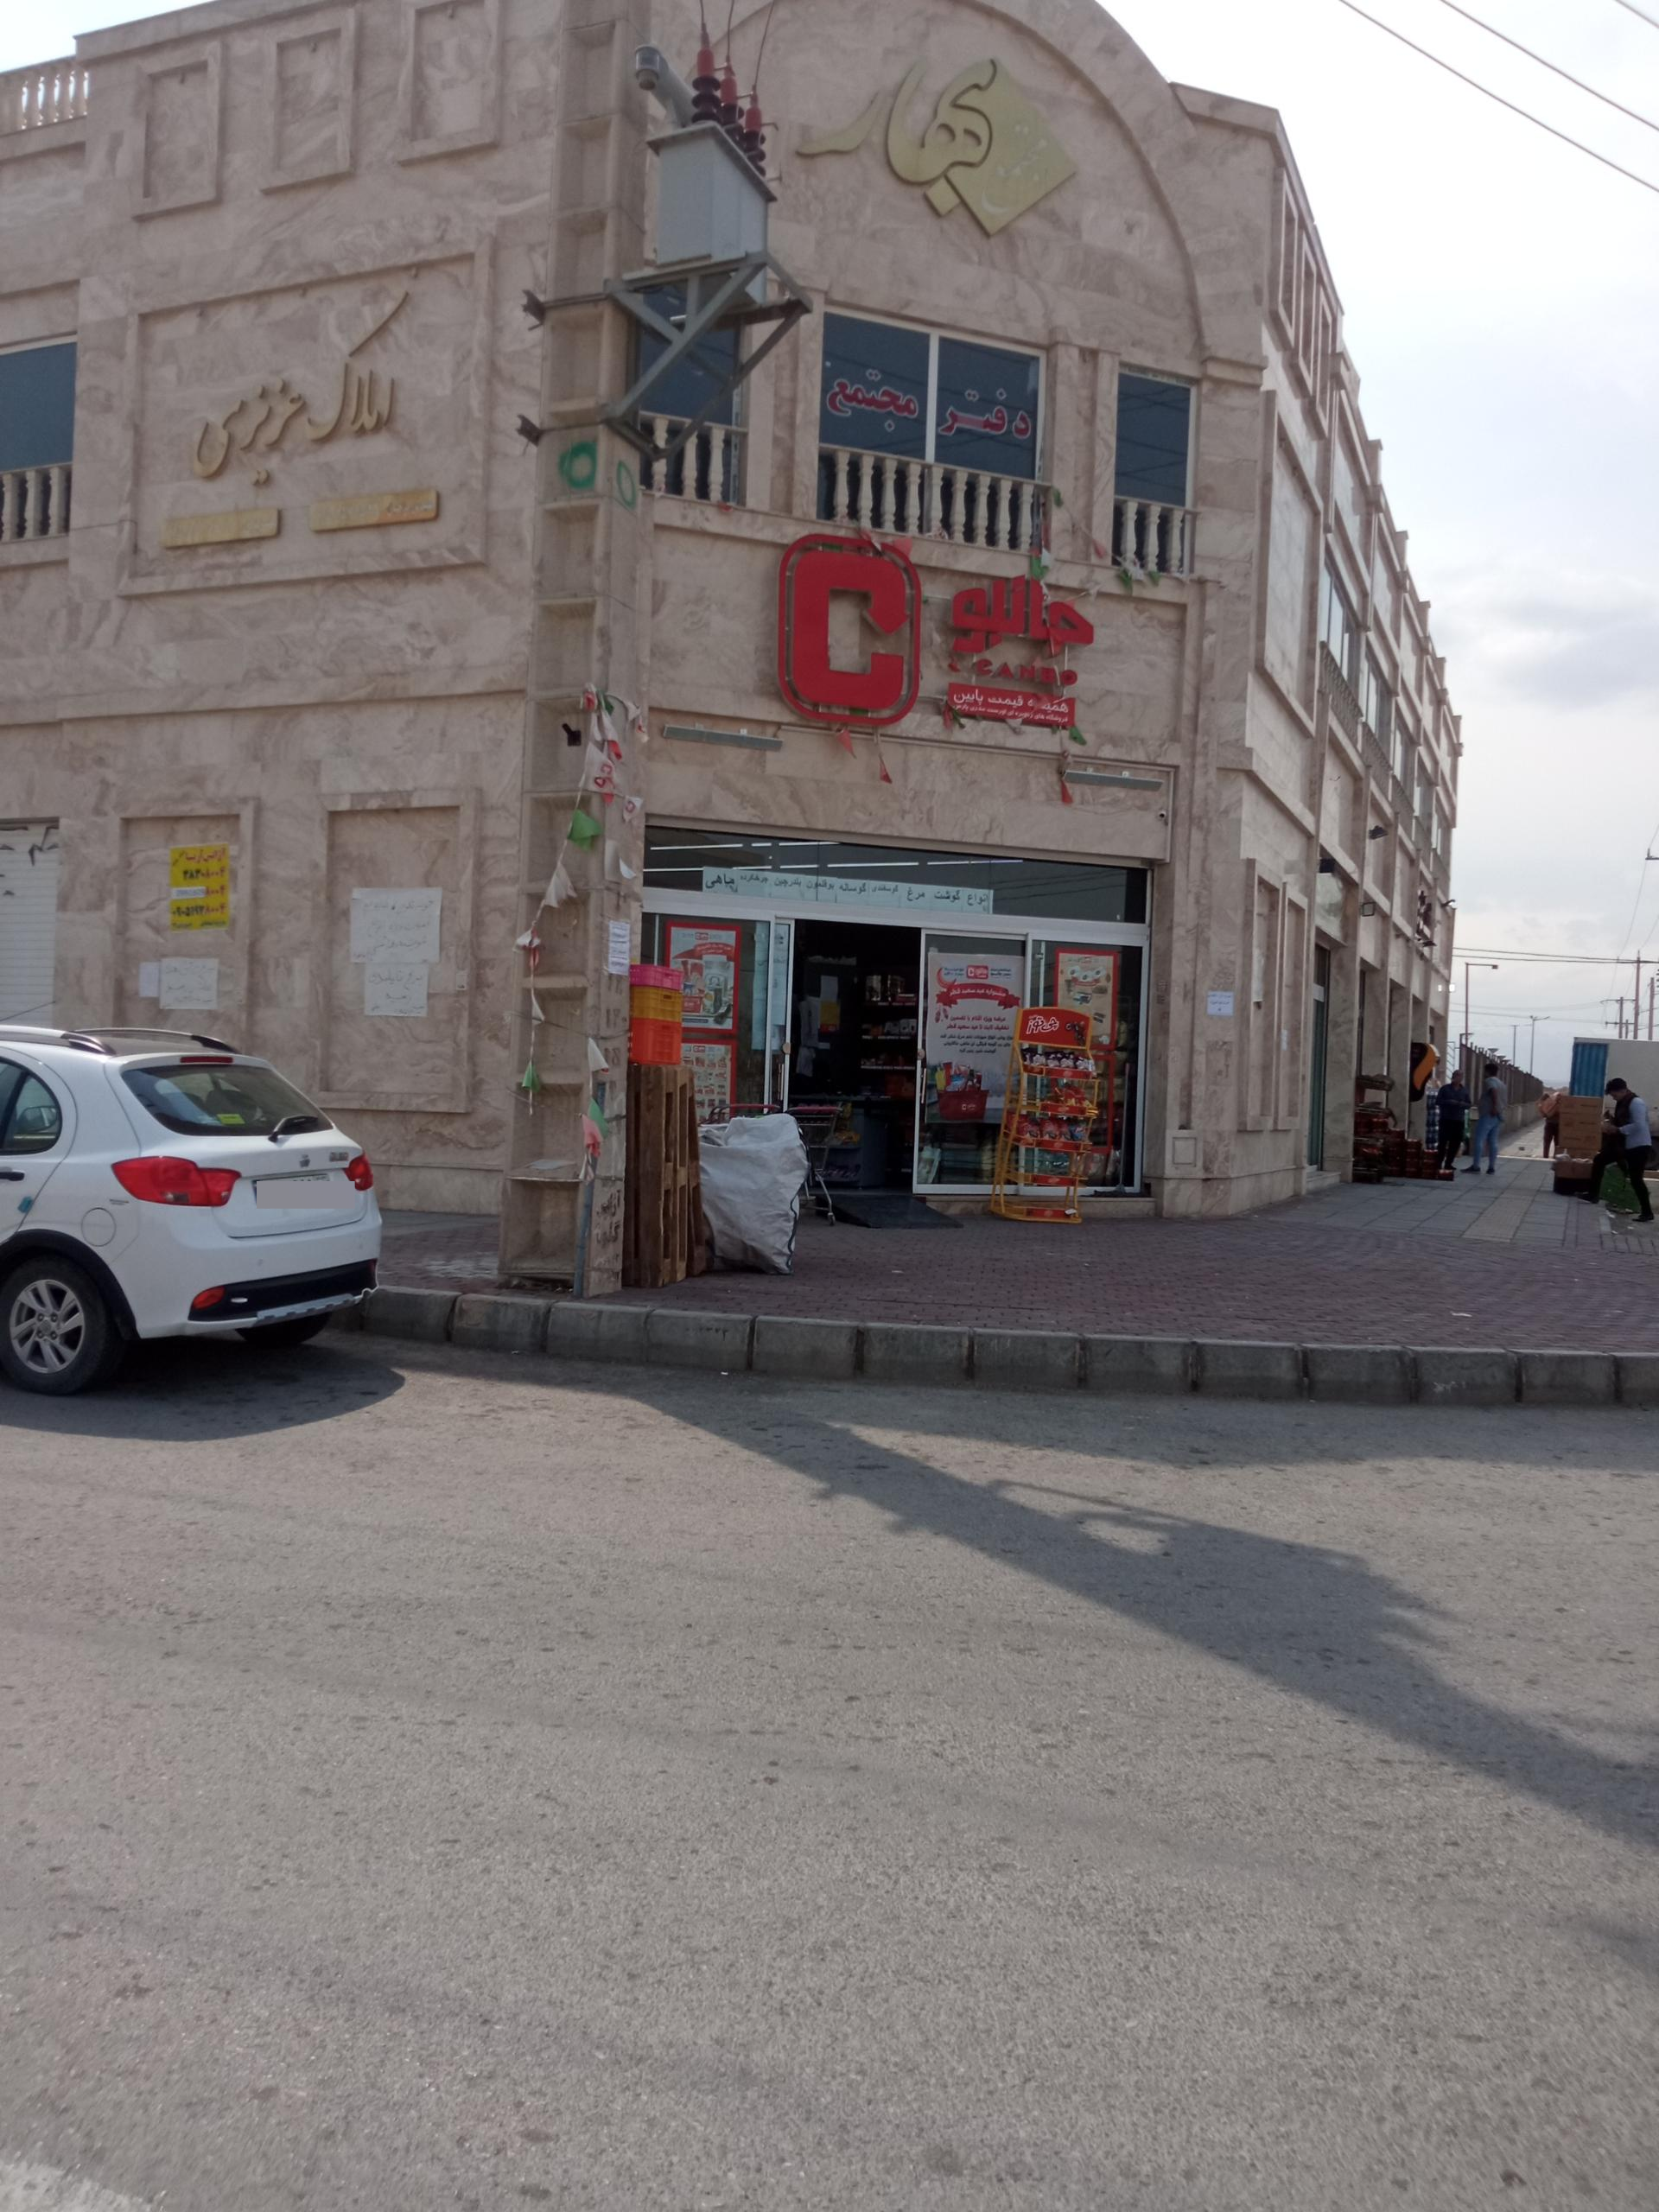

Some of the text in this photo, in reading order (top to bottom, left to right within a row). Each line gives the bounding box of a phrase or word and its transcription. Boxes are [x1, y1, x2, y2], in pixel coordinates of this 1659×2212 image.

[191, 291, 409, 486] املاک عزیزی
[827, 368, 1031, 439] دفتر مجتمع
[952, 688, 984, 706] پایین
[988, 694, 1024, 708] قیمت
[705, 872, 735, 890] ماهی
[773, 877, 802, 888] بلدرچین
[806, 878, 835, 891] بوقلمون
[839, 881, 867, 894] گوساله
[906, 886, 926, 902] مرغ
[933, 889, 961, 903] گوشت
